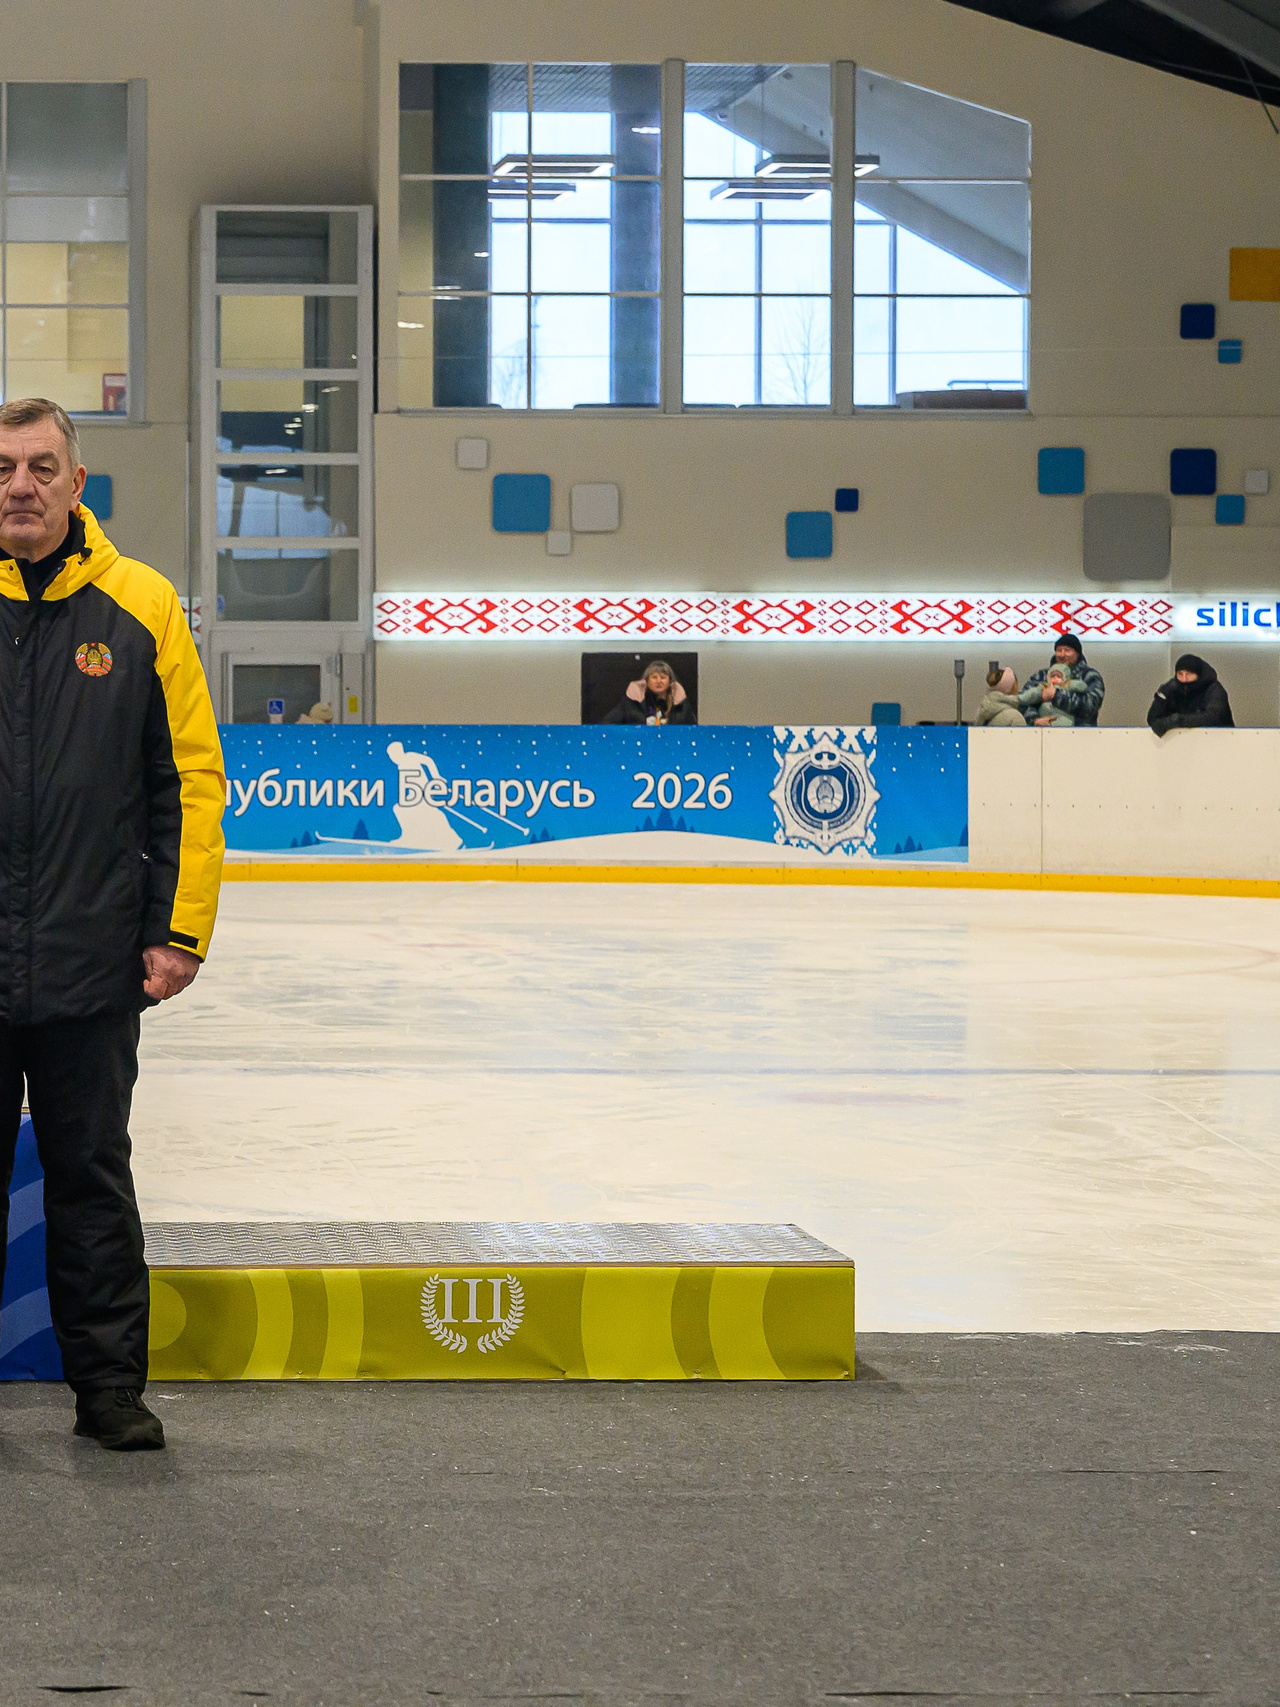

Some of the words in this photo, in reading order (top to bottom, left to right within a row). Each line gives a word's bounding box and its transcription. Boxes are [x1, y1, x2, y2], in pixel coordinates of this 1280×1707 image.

[1196, 601, 1280, 627] silic
[225, 767, 386, 818] ублики
[397, 768, 596, 818] Беларусь
[631, 771, 733, 810] 2026
[439, 1278, 510, 1324] III
